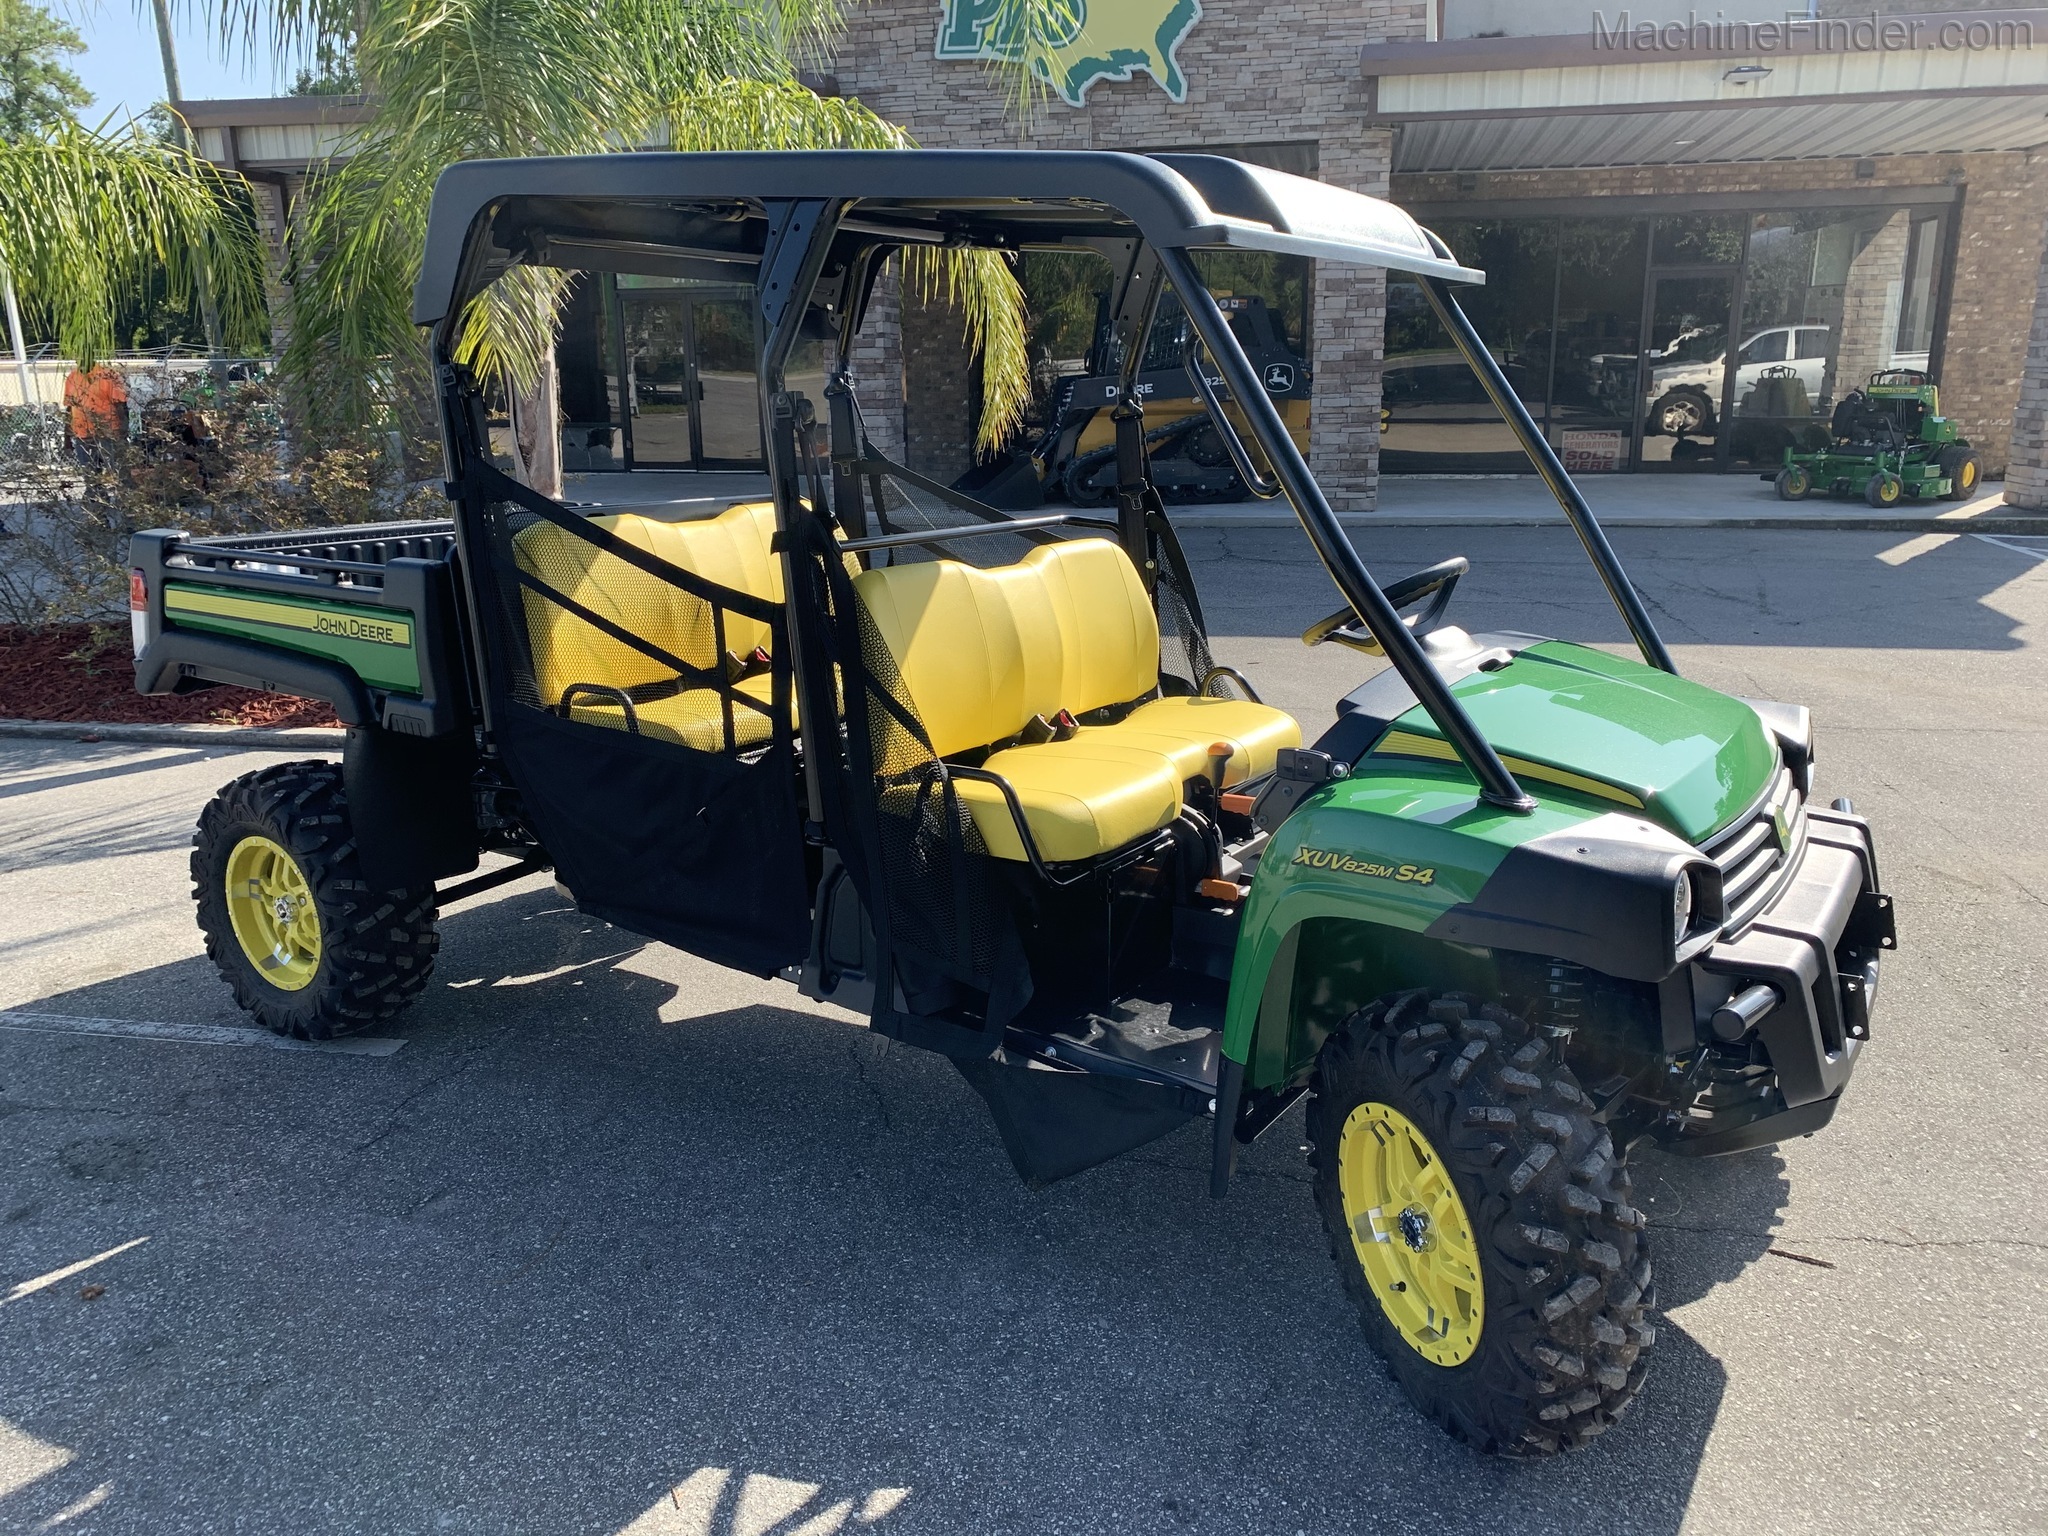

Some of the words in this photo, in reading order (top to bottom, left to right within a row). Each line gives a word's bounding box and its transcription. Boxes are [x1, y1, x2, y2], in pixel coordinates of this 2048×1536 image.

[1105, 383, 1154, 398] DRE
[1564, 432, 1618, 440] HONDA
[1563, 440, 1619, 449] GENERATORS
[1565, 450, 1616, 460] SOLD
[1565, 460, 1614, 470] HERE
[312, 613, 347, 634] JOHN
[349, 619, 394, 642] DEERE
[1395, 864, 1435, 885] S4
